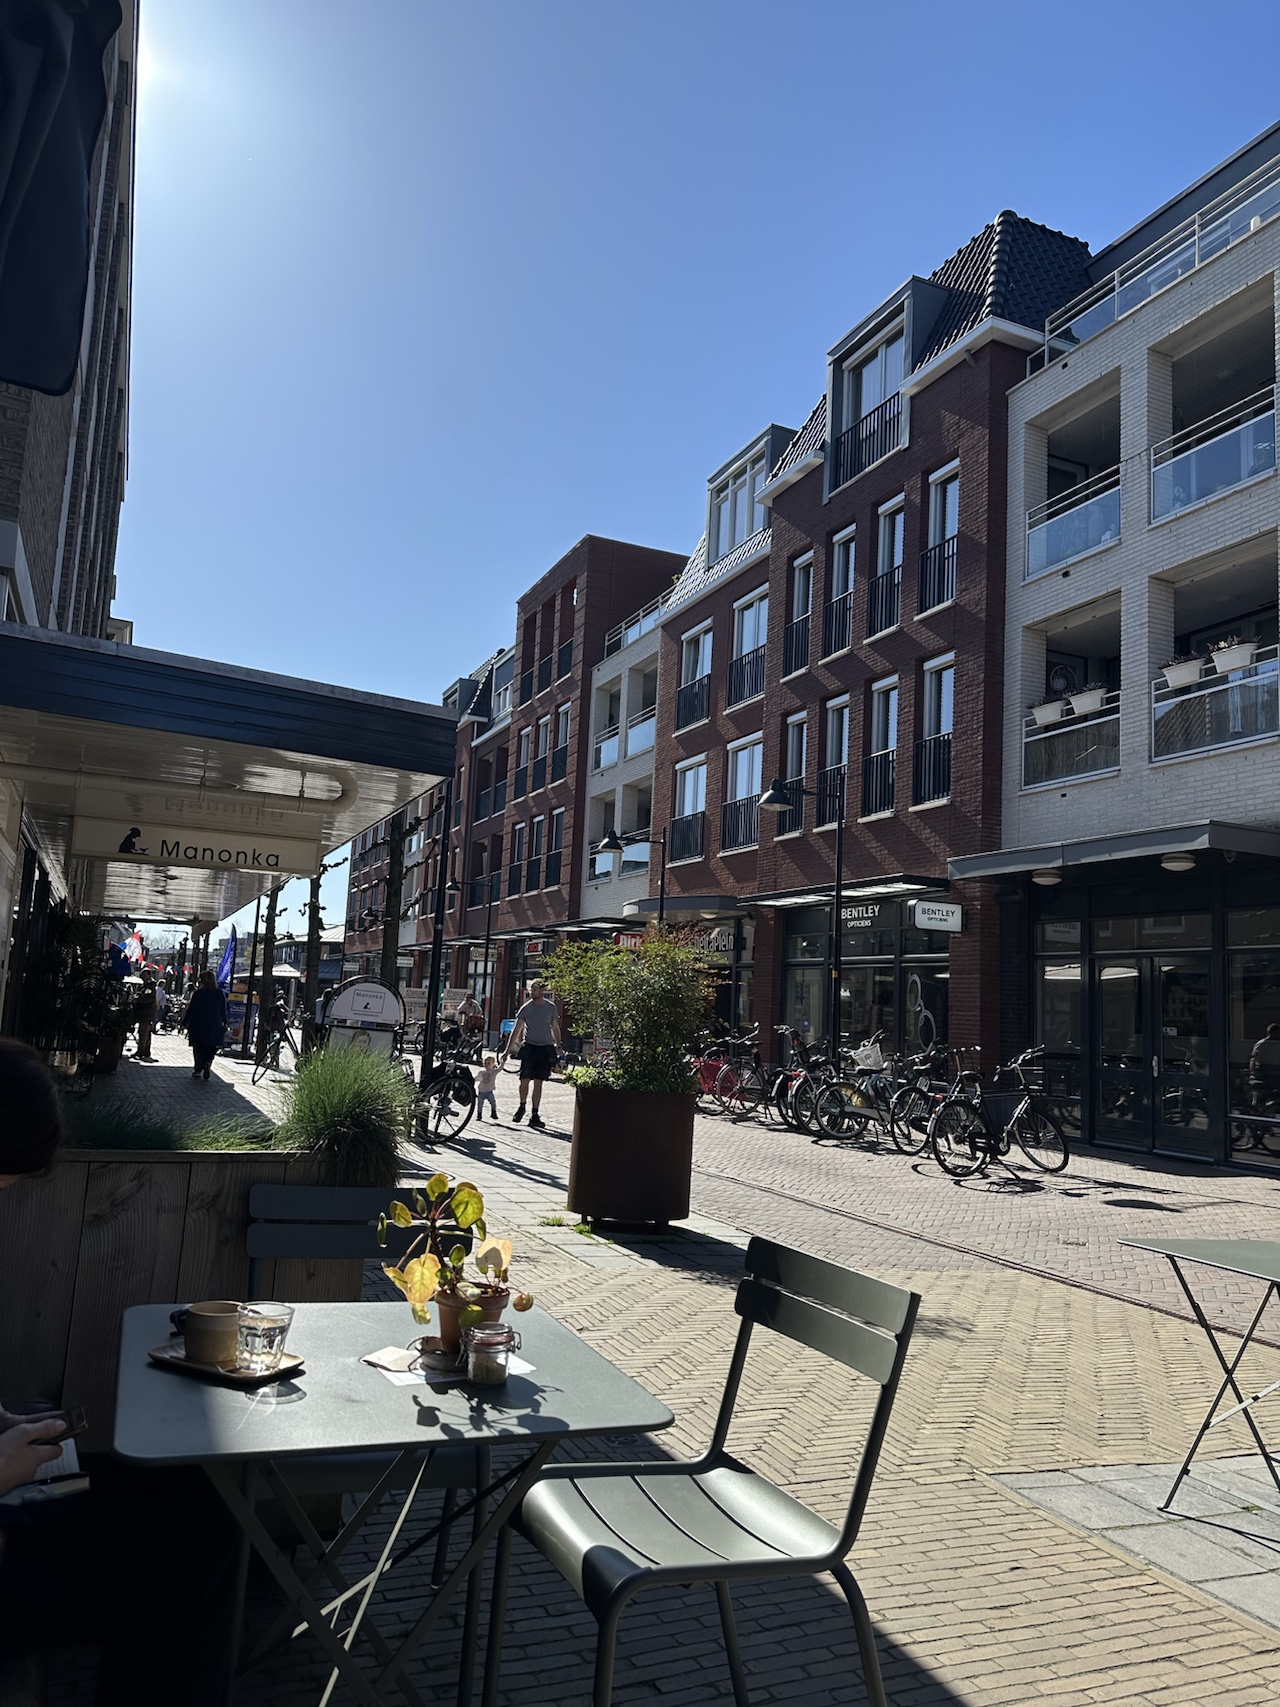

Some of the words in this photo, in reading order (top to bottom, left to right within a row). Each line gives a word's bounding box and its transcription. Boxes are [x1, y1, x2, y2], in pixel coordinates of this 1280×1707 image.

[160, 839, 280, 867] Manonka
[841, 905, 880, 919] BENTLEY
[921, 907, 956, 918] BENTLEY
[847, 919, 872, 928] OPTICIENS
[356, 992, 383, 1000] Manonka
